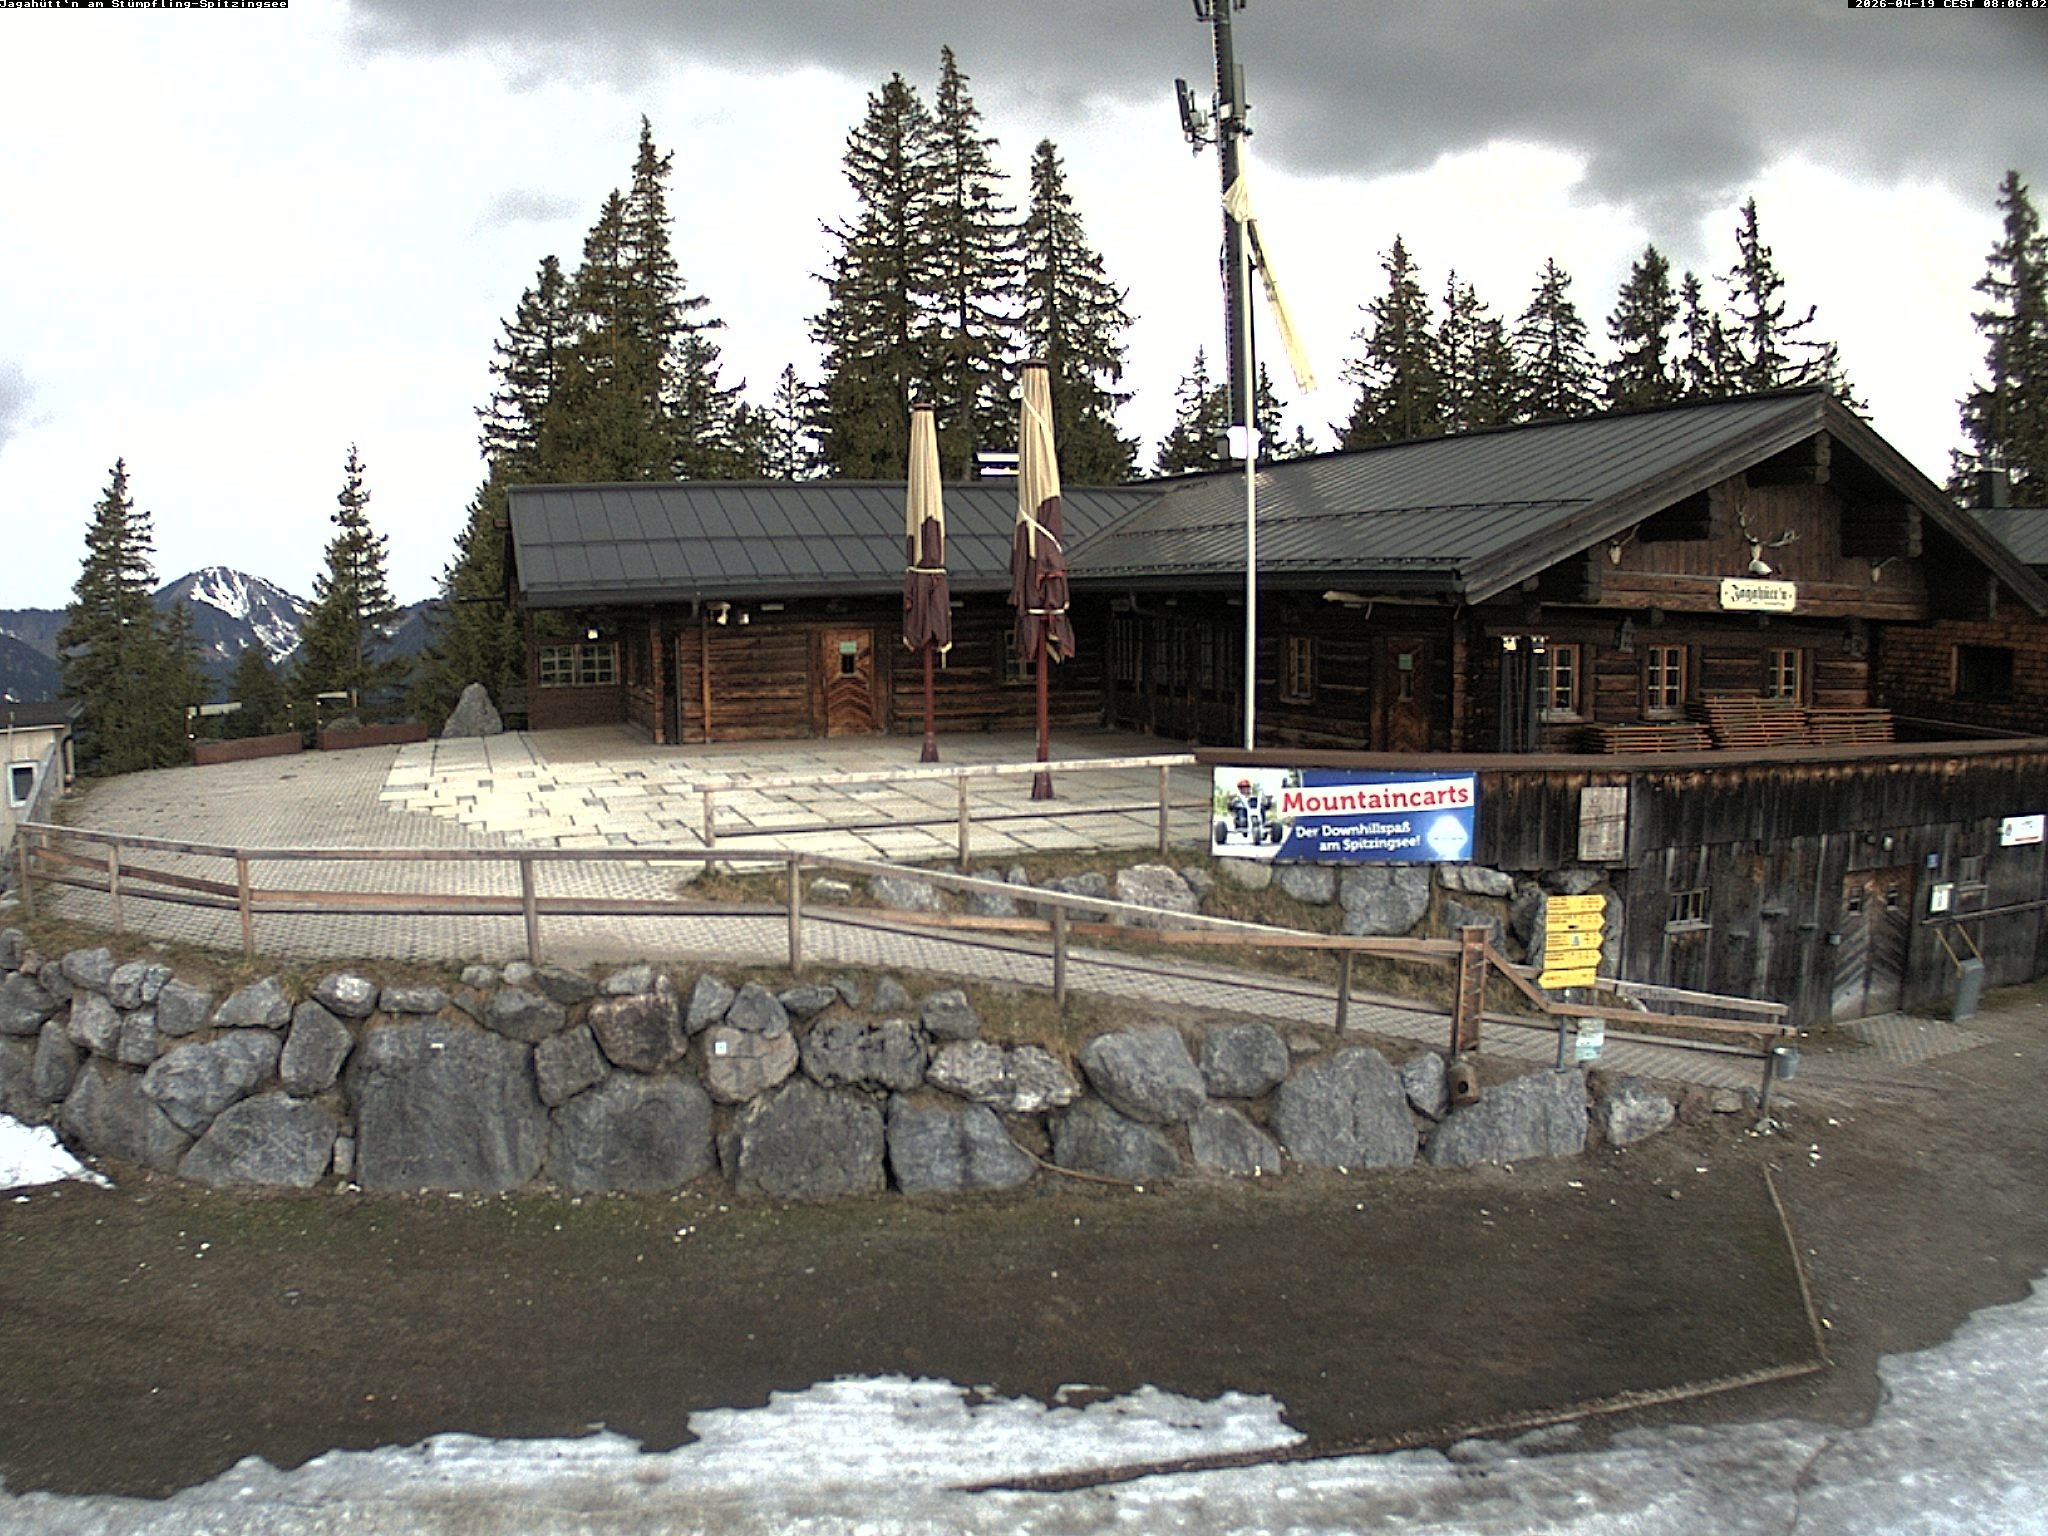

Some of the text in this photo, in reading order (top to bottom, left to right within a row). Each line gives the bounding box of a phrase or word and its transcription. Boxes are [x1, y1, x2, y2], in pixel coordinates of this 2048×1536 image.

[1282, 786, 1469, 813] Mountaincarts
[1296, 821, 1411, 838] Der Downhillspaß
[1319, 835, 1421, 852] am Spitzingsee!
